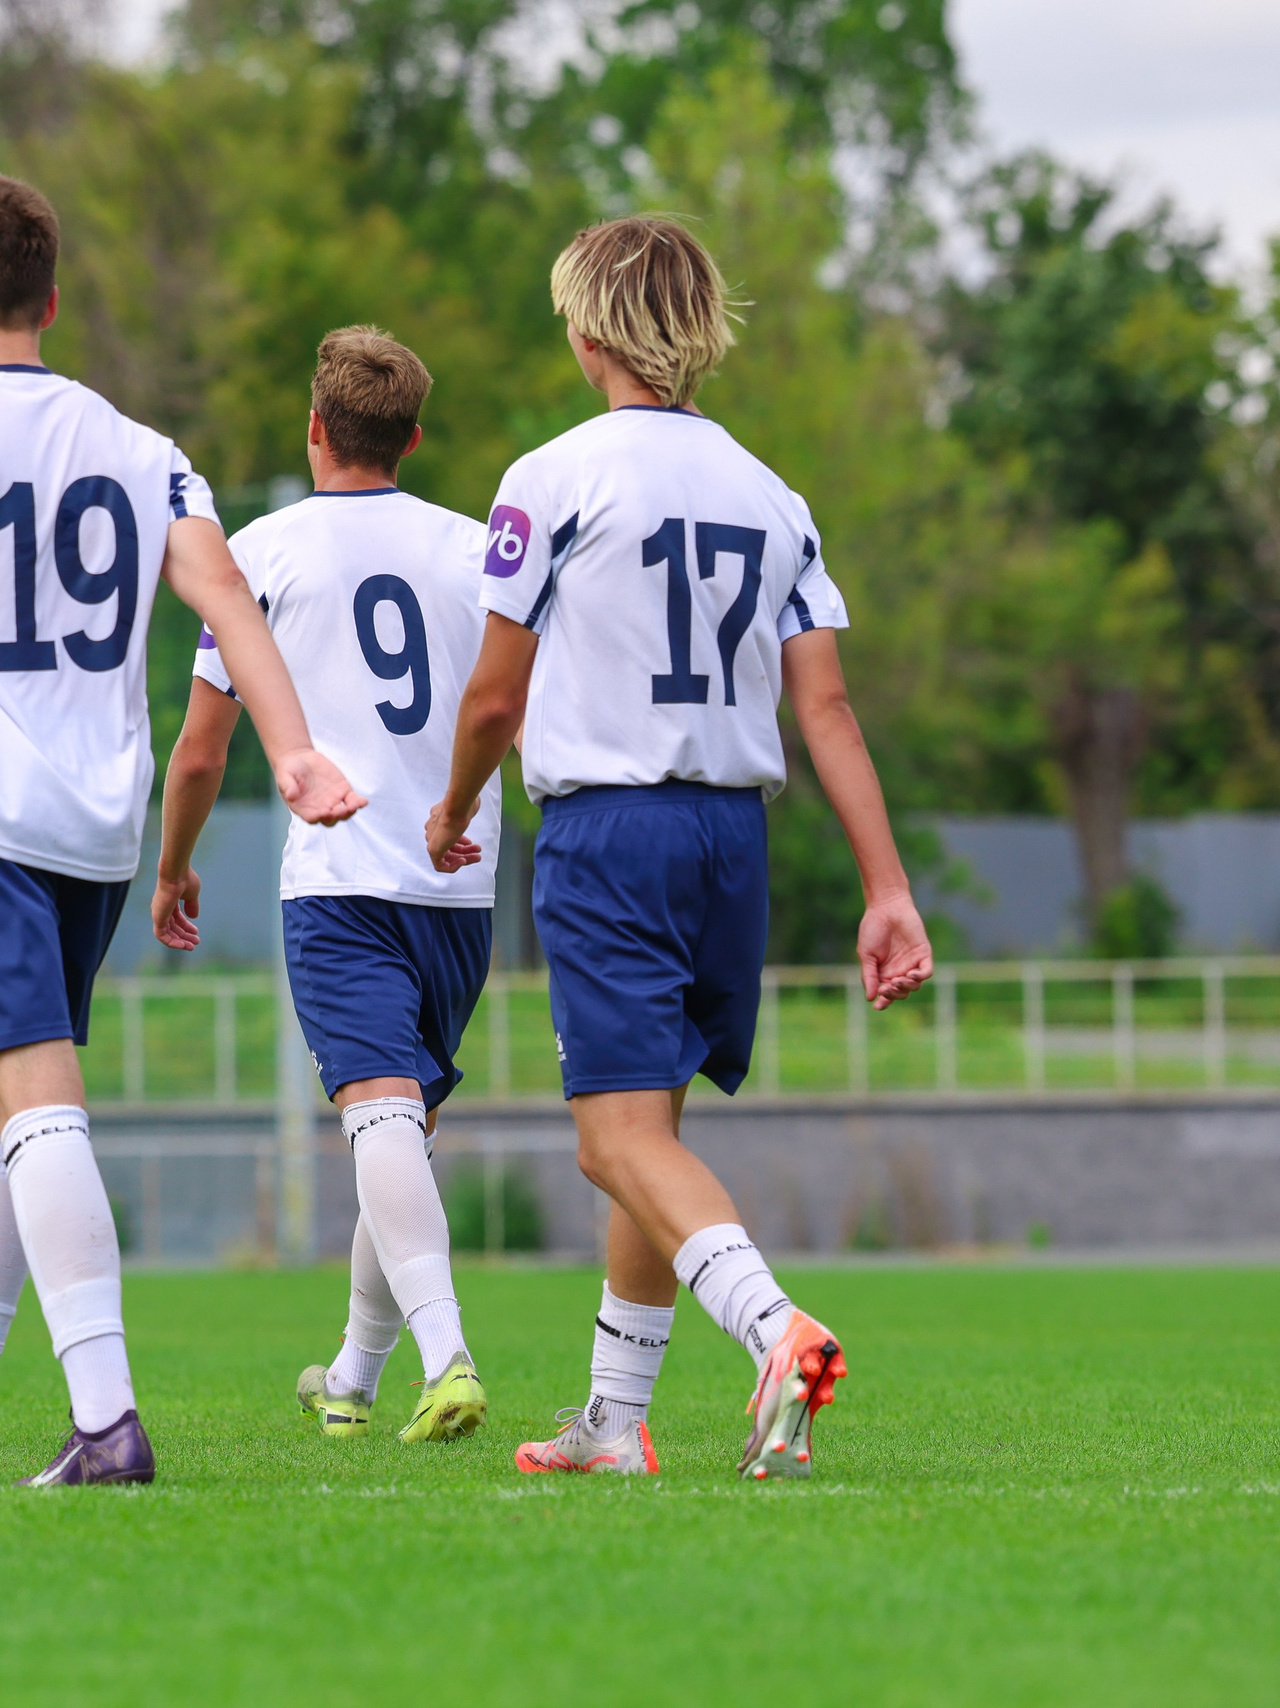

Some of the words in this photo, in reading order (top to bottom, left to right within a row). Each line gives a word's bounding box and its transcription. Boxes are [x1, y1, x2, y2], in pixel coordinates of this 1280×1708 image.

[353, 574, 433, 736] 9
[642, 518, 766, 707] 17
[357, 1113, 417, 1133] KELME
